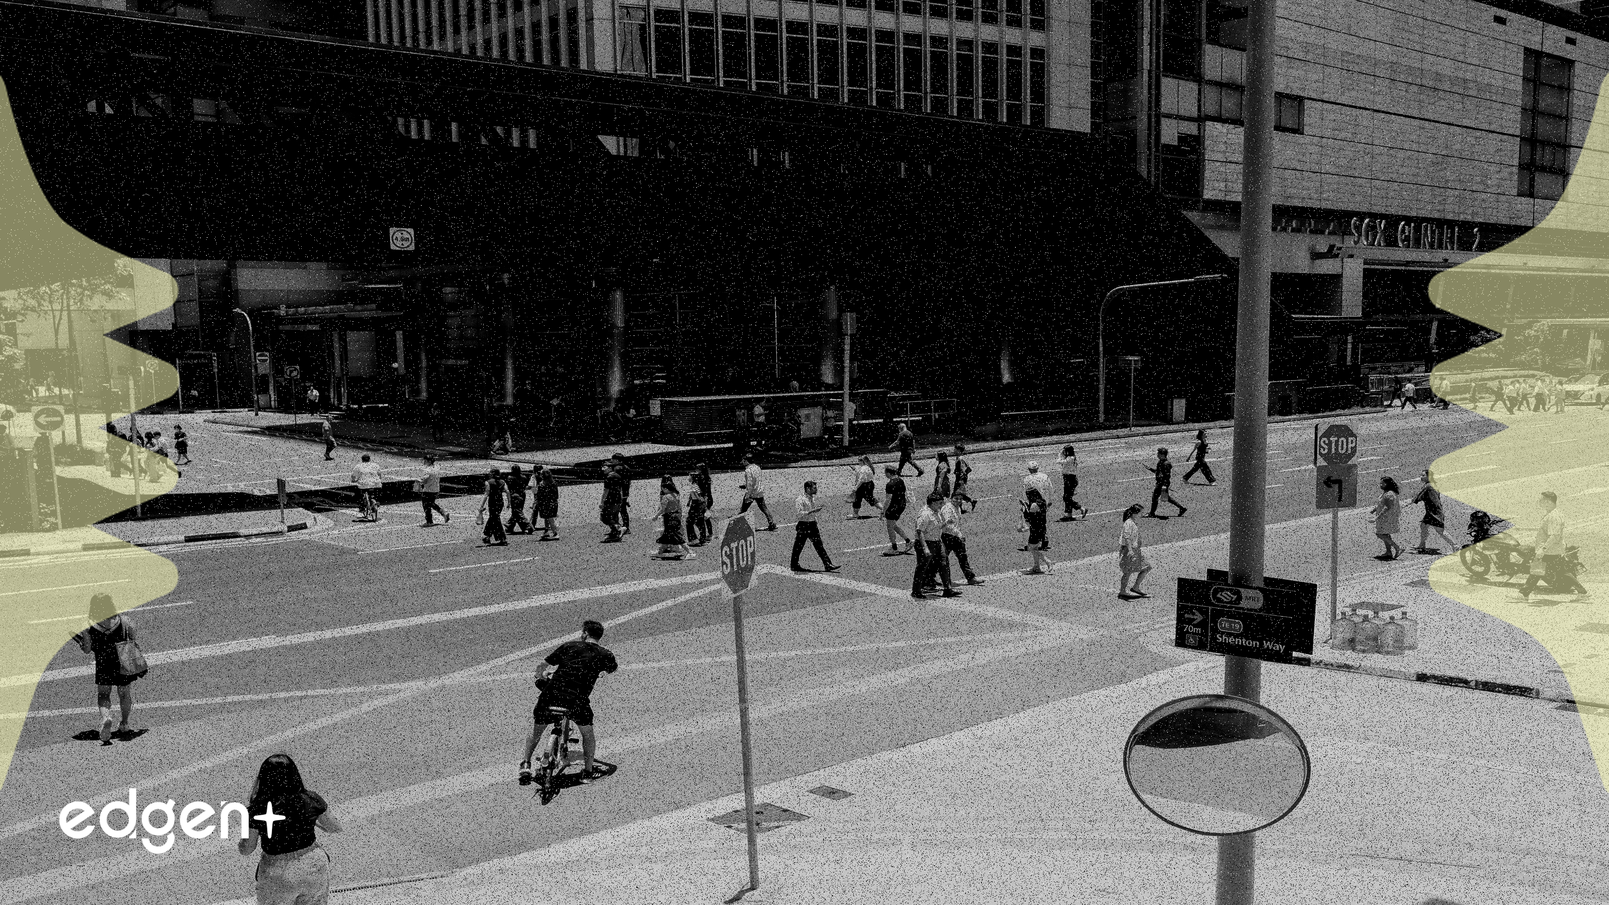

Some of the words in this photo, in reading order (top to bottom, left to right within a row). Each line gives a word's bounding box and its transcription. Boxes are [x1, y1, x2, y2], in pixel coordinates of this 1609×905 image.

[1351, 217, 1386, 246] SGX
[1320, 437, 1356, 454] STOP
[722, 536, 754, 574] STOP
[1183, 624, 1202, 633] 70m
[1216, 633, 1260, 648] Shenton
[1263, 640, 1286, 653] Way
